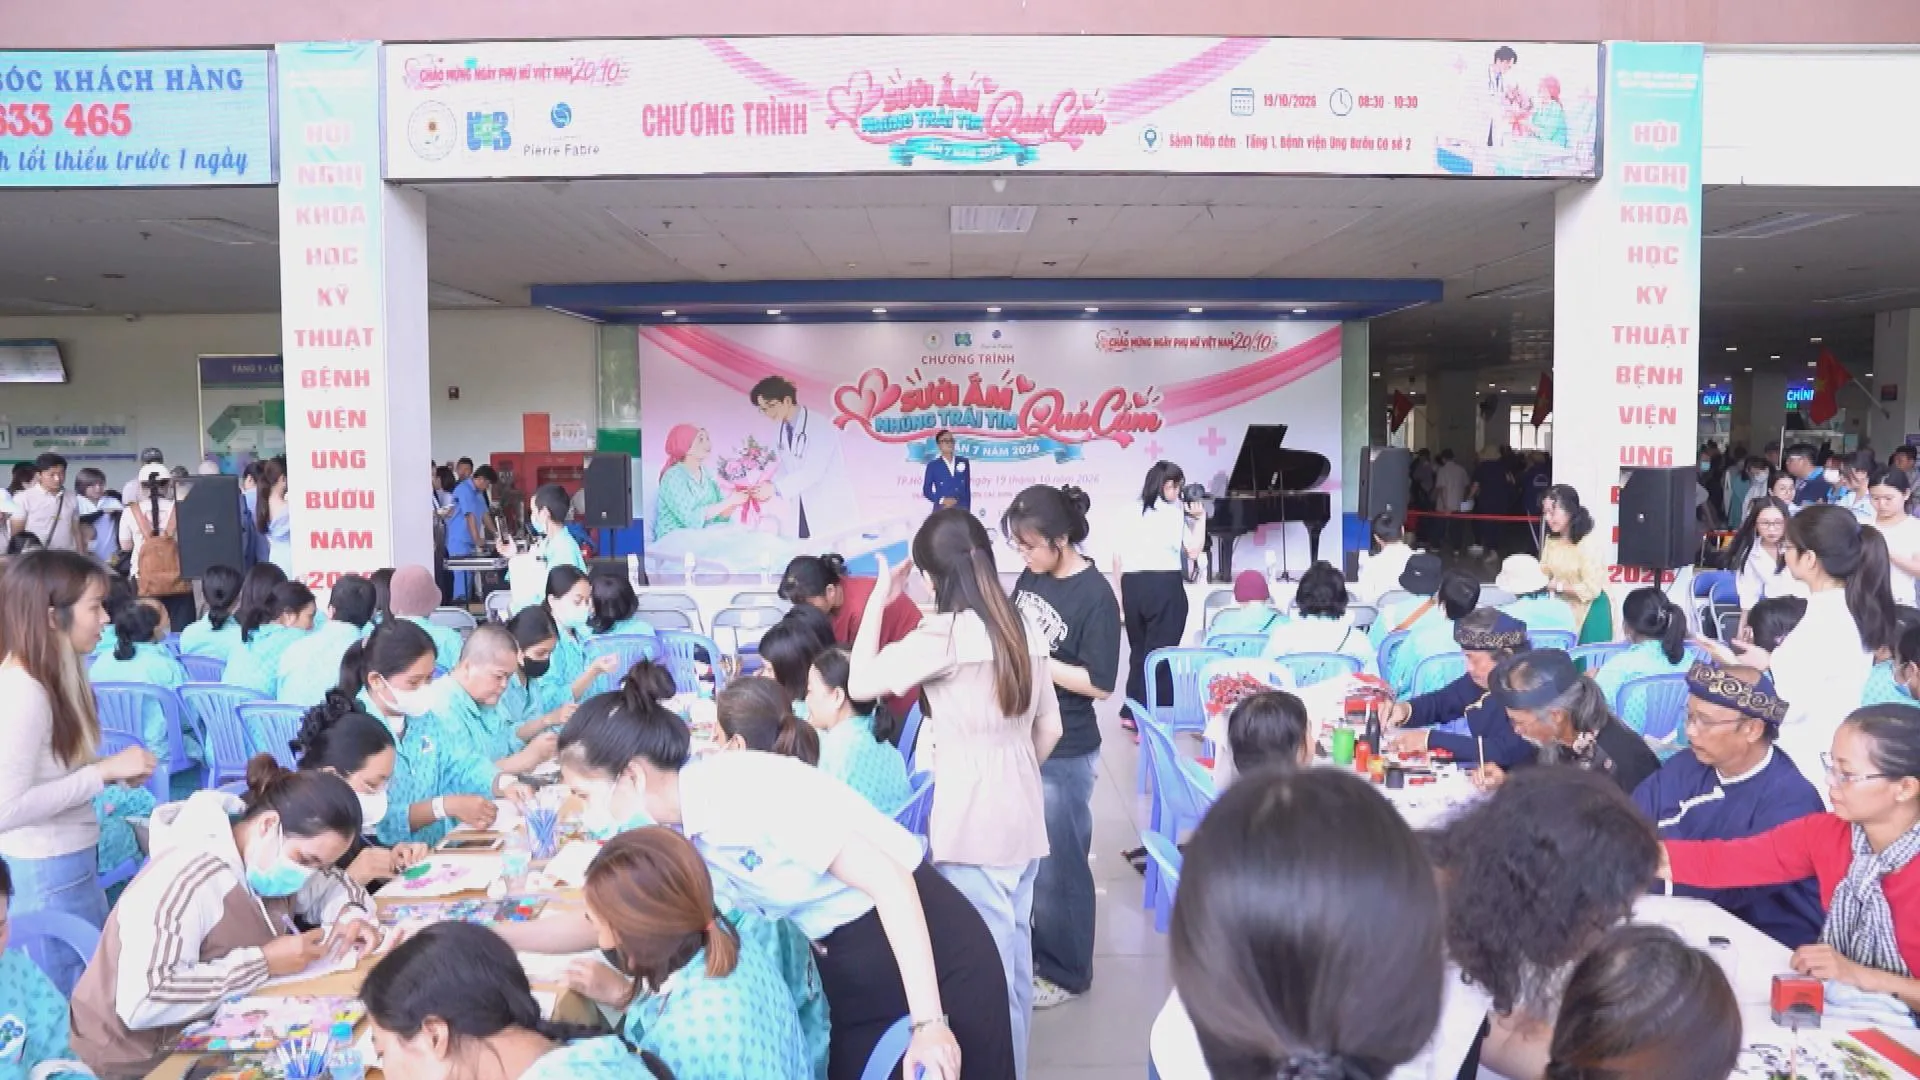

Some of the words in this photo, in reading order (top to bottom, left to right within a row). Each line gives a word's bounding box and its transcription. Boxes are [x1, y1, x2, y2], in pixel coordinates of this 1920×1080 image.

[0, 64, 42, 92] ÓC
[54, 64, 153, 92] KHÁCH
[165, 65, 244, 92] HÀNG
[1358, 95, 1384, 108] 08:30
[1394, 95, 1418, 108] 10:30
[64, 103, 132, 137] 465
[641, 101, 735, 137] CHƯƠNG
[743, 95, 808, 136] TRÌNH
[1406, 138, 1412, 151] 2
[1633, 121, 1678, 149] HỘI
[19, 144, 46, 171] tối
[116, 147, 171, 170] trước
[179, 148, 186, 169] 1
[195, 146, 249, 176] ngày
[523, 143, 561, 156] Pierre
[564, 143, 600, 156] Fabre
[1623, 164, 1687, 189] NGHỊ
[296, 205, 366, 226] KHOA
[1620, 205, 1688, 225] KHOA
[305, 246, 358, 270] HỌC
[1627, 245, 1680, 269] HỌC
[294, 326, 374, 352] THUẬT
[1611, 323, 1690, 348] THUẬT
[921, 353, 975, 365] CHƯƠNG
[978, 351, 1015, 365] TRÌNH
[301, 365, 371, 393] BỆNH
[1616, 363, 1683, 389] BỆNH
[307, 406, 367, 433] VIỆN
[985, 412, 1018, 431] TIM
[1619, 403, 1677, 429] VIỆN
[17, 425, 50, 436] KHOA
[311, 449, 367, 469] UNG
[972, 444, 980, 455] 7
[982, 443, 1009, 456] NĂM
[1012, 442, 1040, 455] 2026
[1619, 446, 1673, 467] UNG
[310, 527, 373, 549] NĂM
[308, 571, 372, 589] 20
